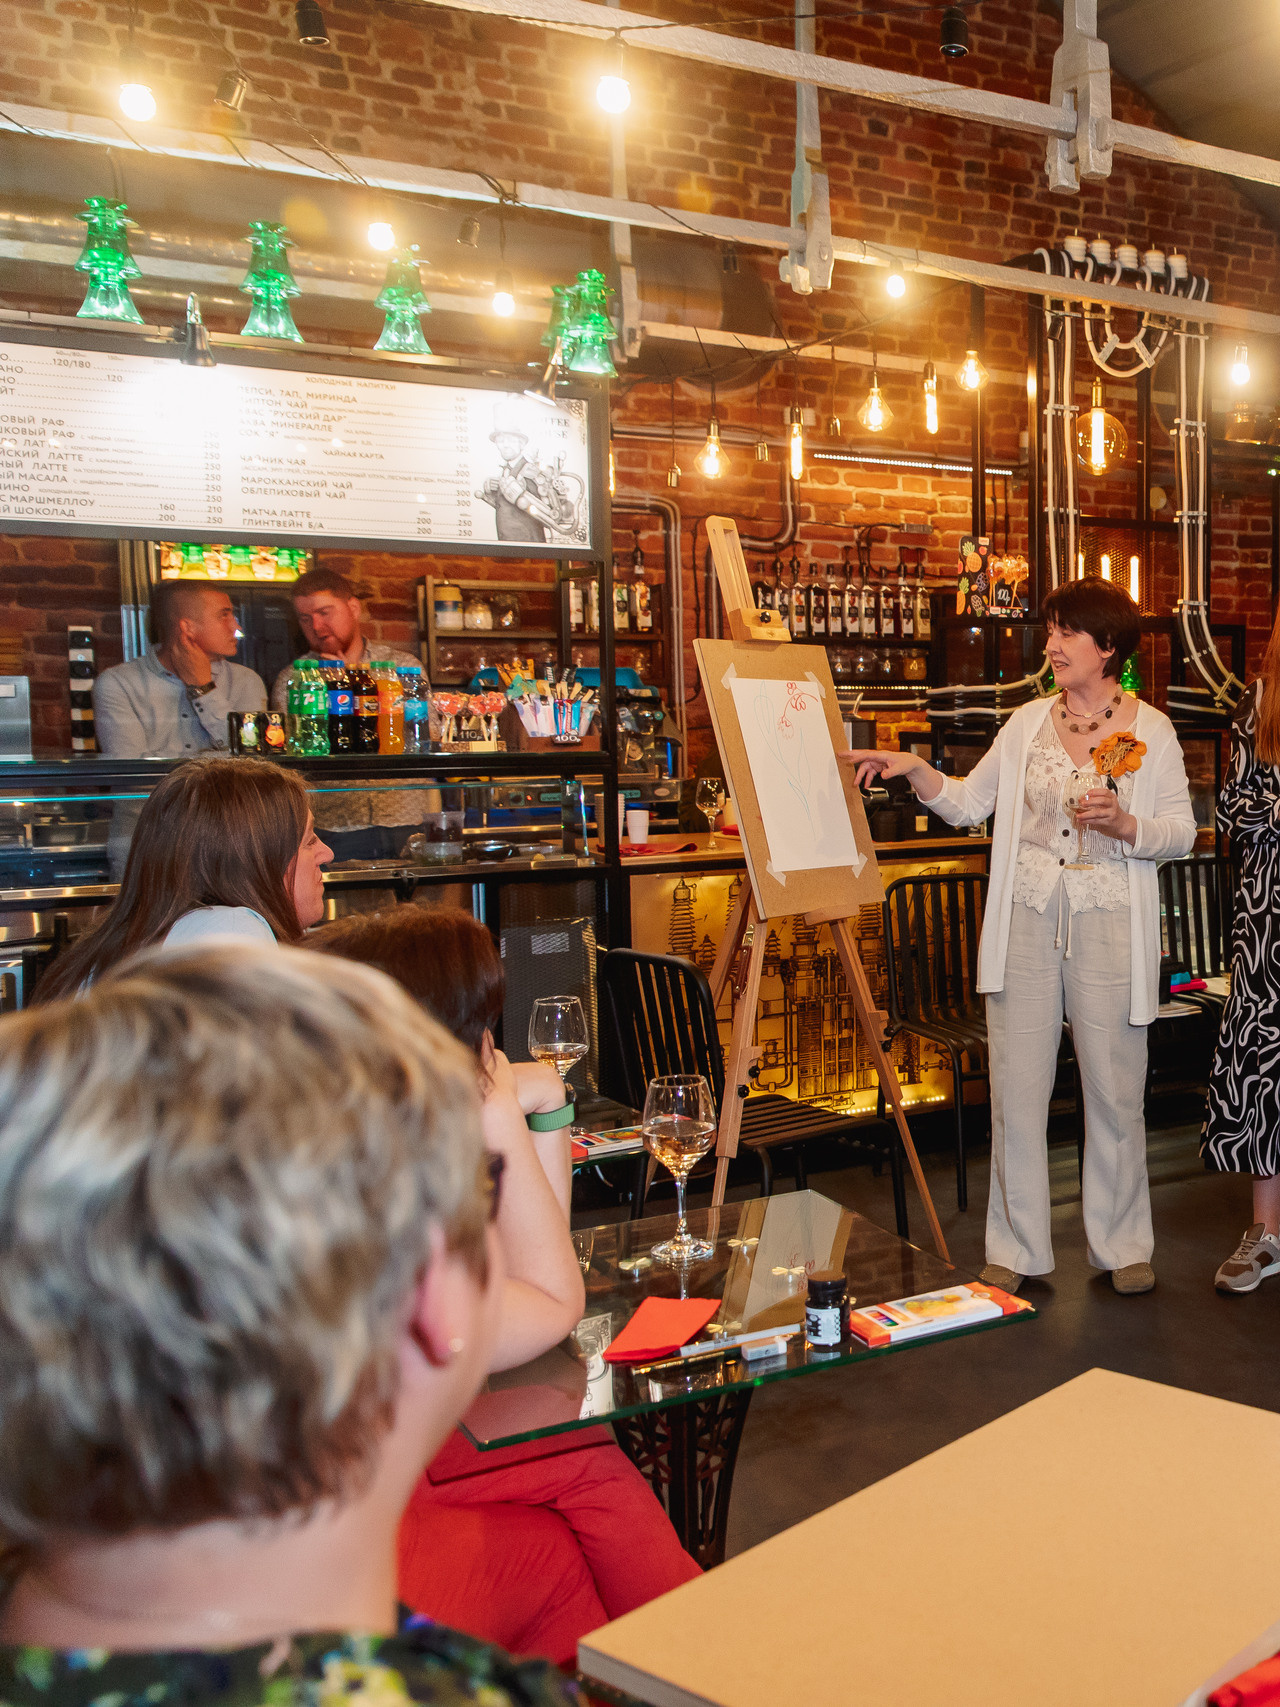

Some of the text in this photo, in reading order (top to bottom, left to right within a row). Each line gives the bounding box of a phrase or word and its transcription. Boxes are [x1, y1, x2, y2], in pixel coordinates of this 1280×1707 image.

[52, 358, 91, 369] 120/180
[106, 375, 123, 383] 120
[305, 376, 396, 391] ХОЛОДНЫЕ НАПИТКИ
[306, 391, 358, 403] МИРИНДА
[285, 400, 308, 409] ЧАЙ
[41, 417, 65, 426] РАФ
[271, 420, 332, 433] МИНЕРАЛЛЕ
[0, 425, 46, 437] КОВЫЙ
[52, 429, 75, 439] РАФ
[48, 451, 83, 462] ЛАТТЕ
[204, 452, 220, 460] 250
[322, 449, 385, 460] ЧАЙНАЯ КАРТА
[286, 458, 306, 467] ЧАЯ
[32, 462, 68, 472] ЛАТТЕ
[205, 473, 221, 481] 250
[18, 473, 68, 483] МАСАЛА
[205, 484, 222, 492] 250
[240, 475, 471, 497] МАРОККАНСКИЙ ЧАЙ 300
[0, 483, 30, 492] ИНО
[206, 495, 222, 503] 250
[240, 486, 471, 508] ОБЛЕПИХОВЫЙ ЧАЙ 300
[9, 494, 95, 507] МАРШМЕЛЛОУ
[159, 503, 175, 511] 160
[207, 505, 222, 513] 210
[14, 506, 76, 518] ШОКОЛАД
[158, 514, 175, 522] 200
[206, 516, 223, 524] 250
[242, 507, 472, 527] МАТЧА ЛАТТЕ 200 250
[242, 518, 473, 537] ГЛИНТВЕЙН Б/А 200 250
